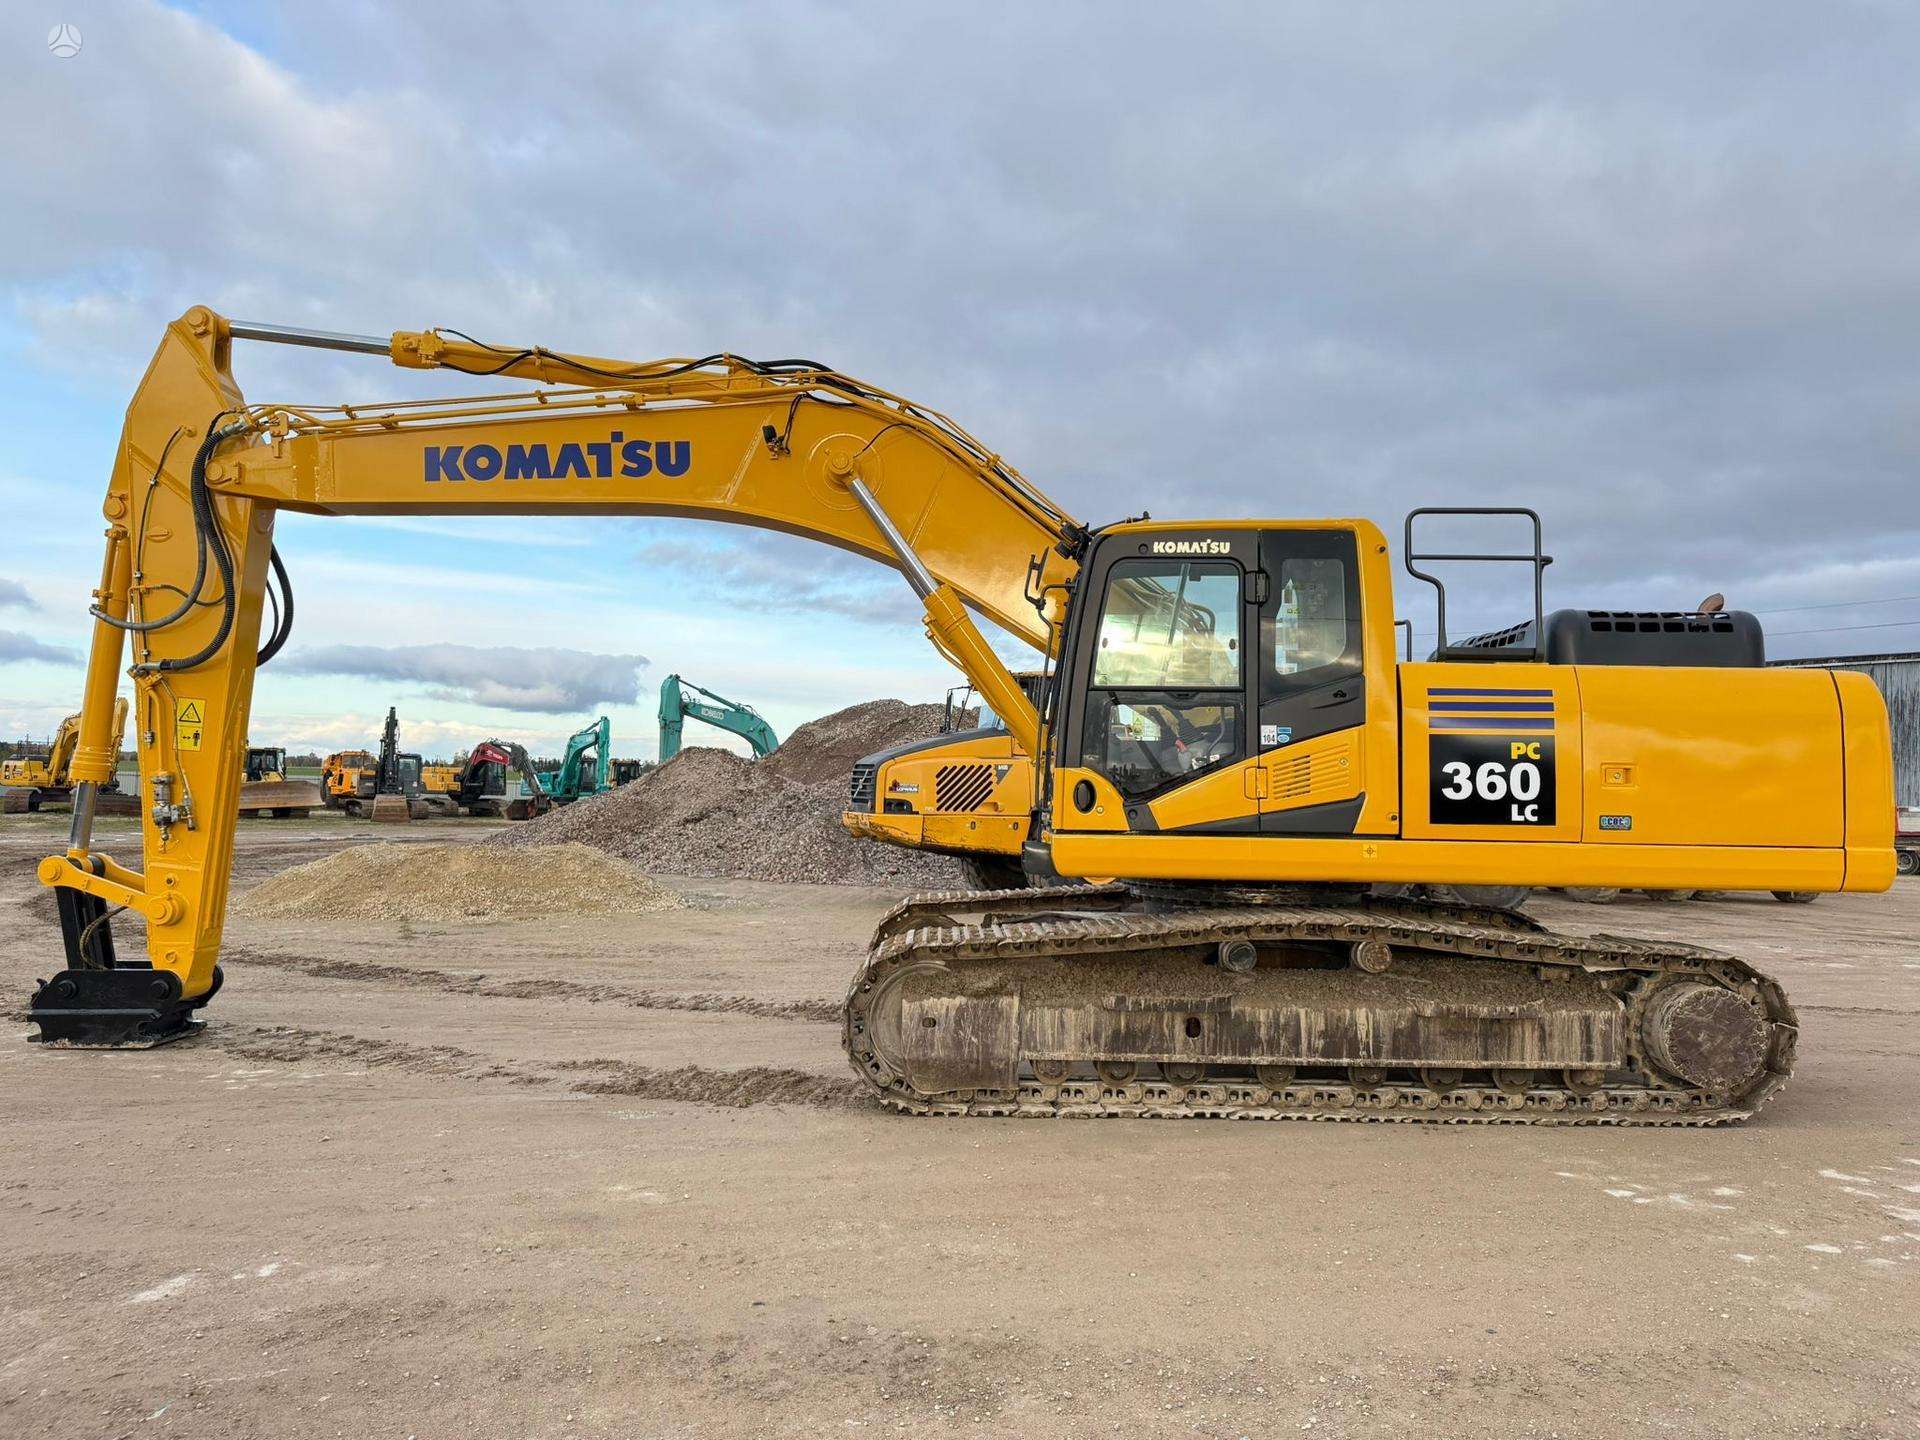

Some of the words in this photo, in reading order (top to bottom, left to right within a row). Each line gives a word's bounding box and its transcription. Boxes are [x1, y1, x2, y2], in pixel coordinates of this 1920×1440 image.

[424, 431, 691, 482] KOMATSU
[1153, 539, 1231, 554] KOMATSU
[1511, 742, 1541, 760] PC
[1441, 761, 1541, 801] 360
[1511, 804, 1538, 821] LC
